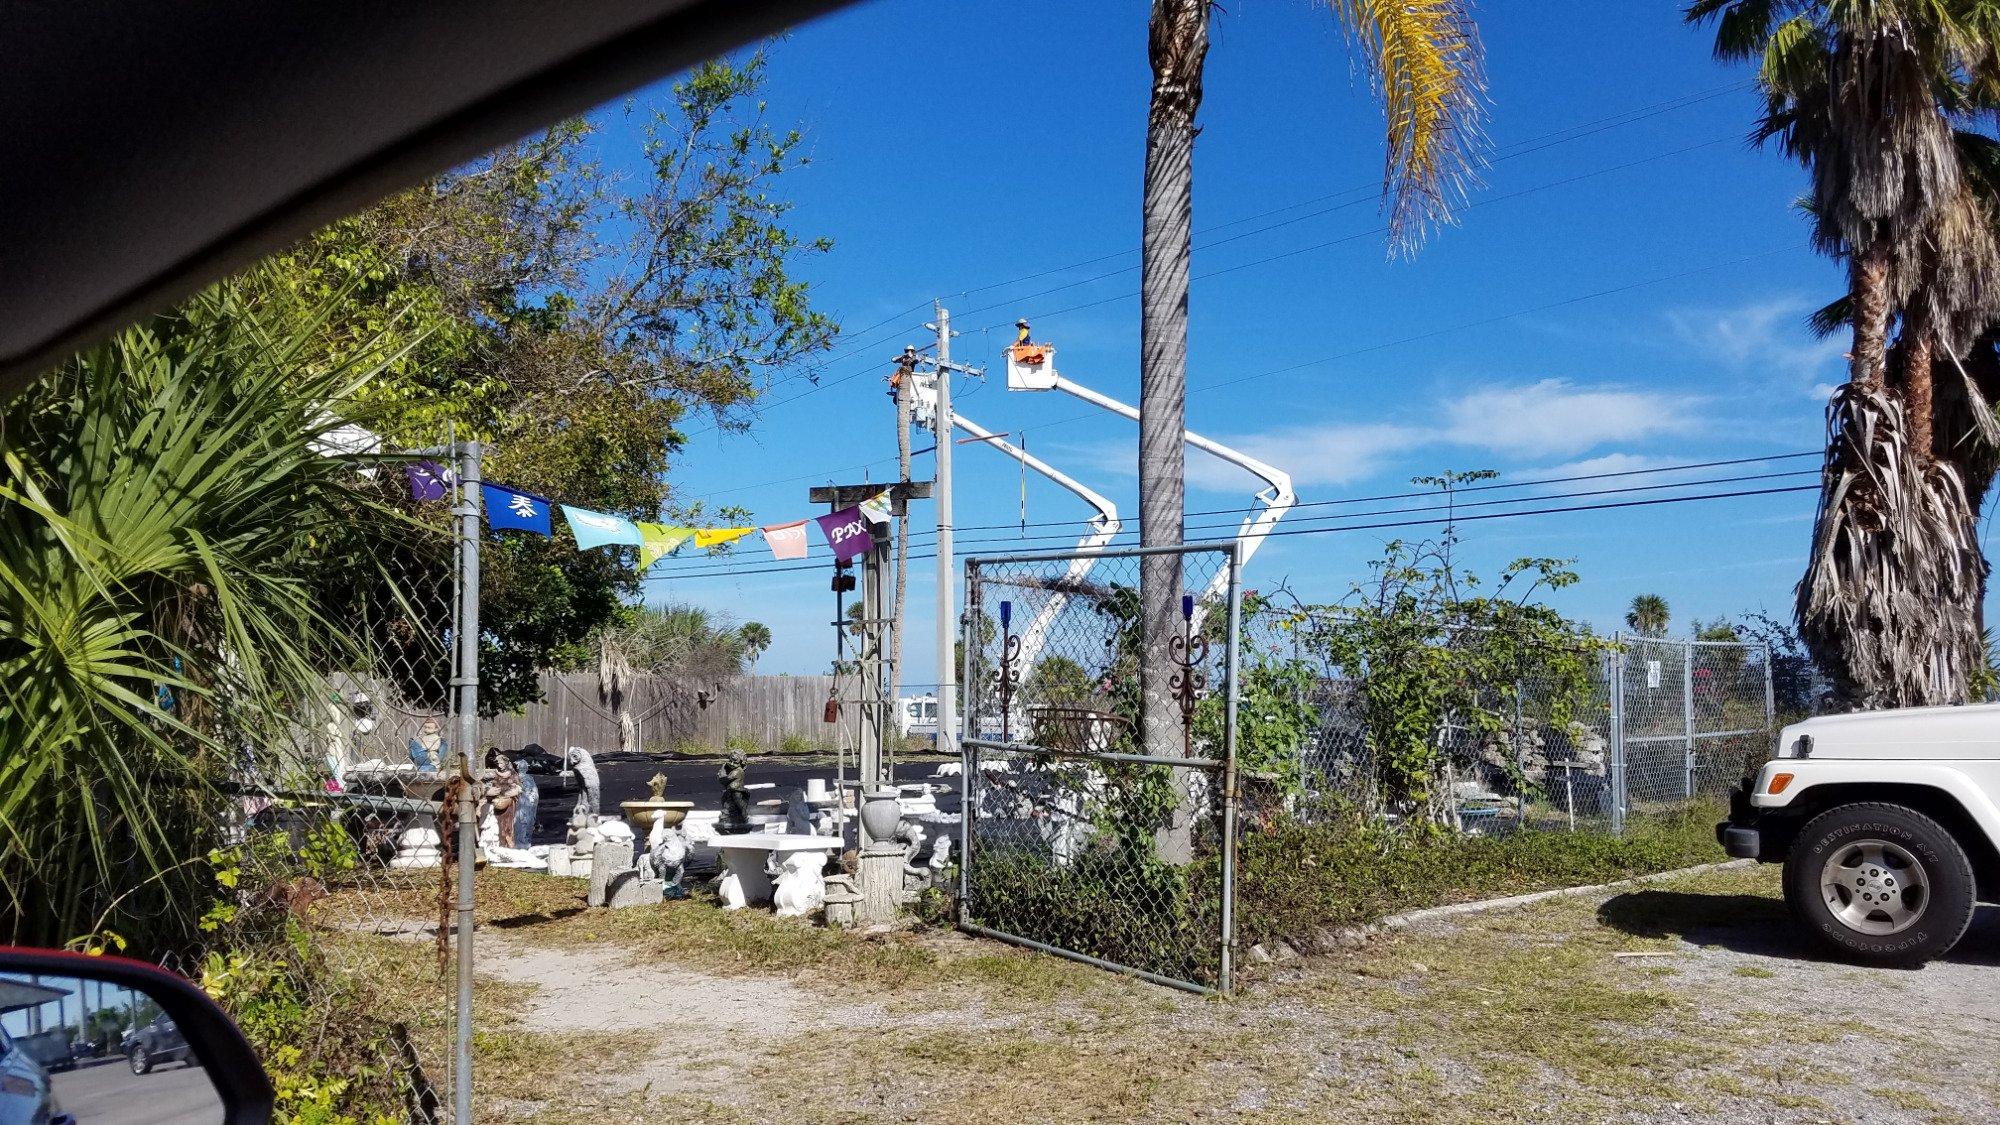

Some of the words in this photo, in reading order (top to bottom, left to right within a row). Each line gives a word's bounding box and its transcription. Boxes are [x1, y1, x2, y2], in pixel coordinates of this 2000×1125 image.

[831, 520, 867, 544] PAX
[1813, 822, 1912, 854] DESTINATION
[1916, 842, 1939, 863] A/T
